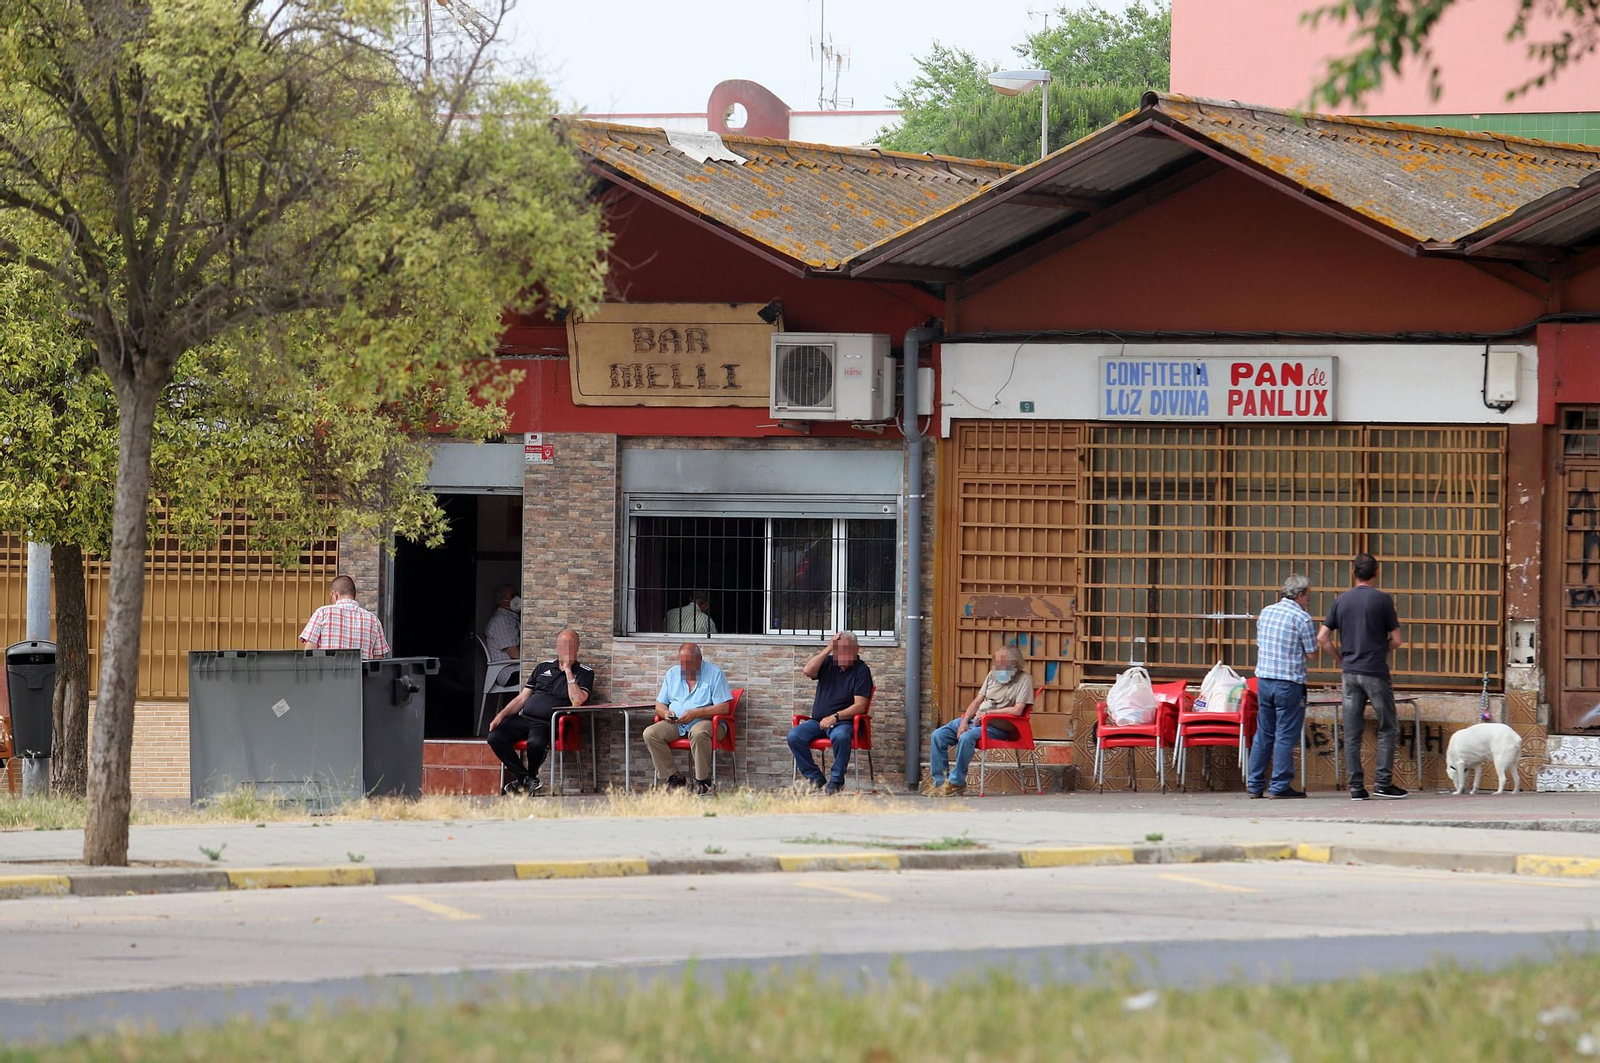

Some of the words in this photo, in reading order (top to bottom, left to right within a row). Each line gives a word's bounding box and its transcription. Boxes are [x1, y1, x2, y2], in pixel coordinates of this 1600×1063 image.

[632, 328, 710, 353] BAR
[608, 363, 742, 389] MELLI
[1106, 362, 1209, 387] CONFITERIA
[1231, 362, 1303, 387] PAN
[1307, 367, 1327, 386] de
[1106, 389, 1143, 415] LUZ
[1149, 389, 1209, 416] DIVINA
[1227, 389, 1328, 416] PANLUX
